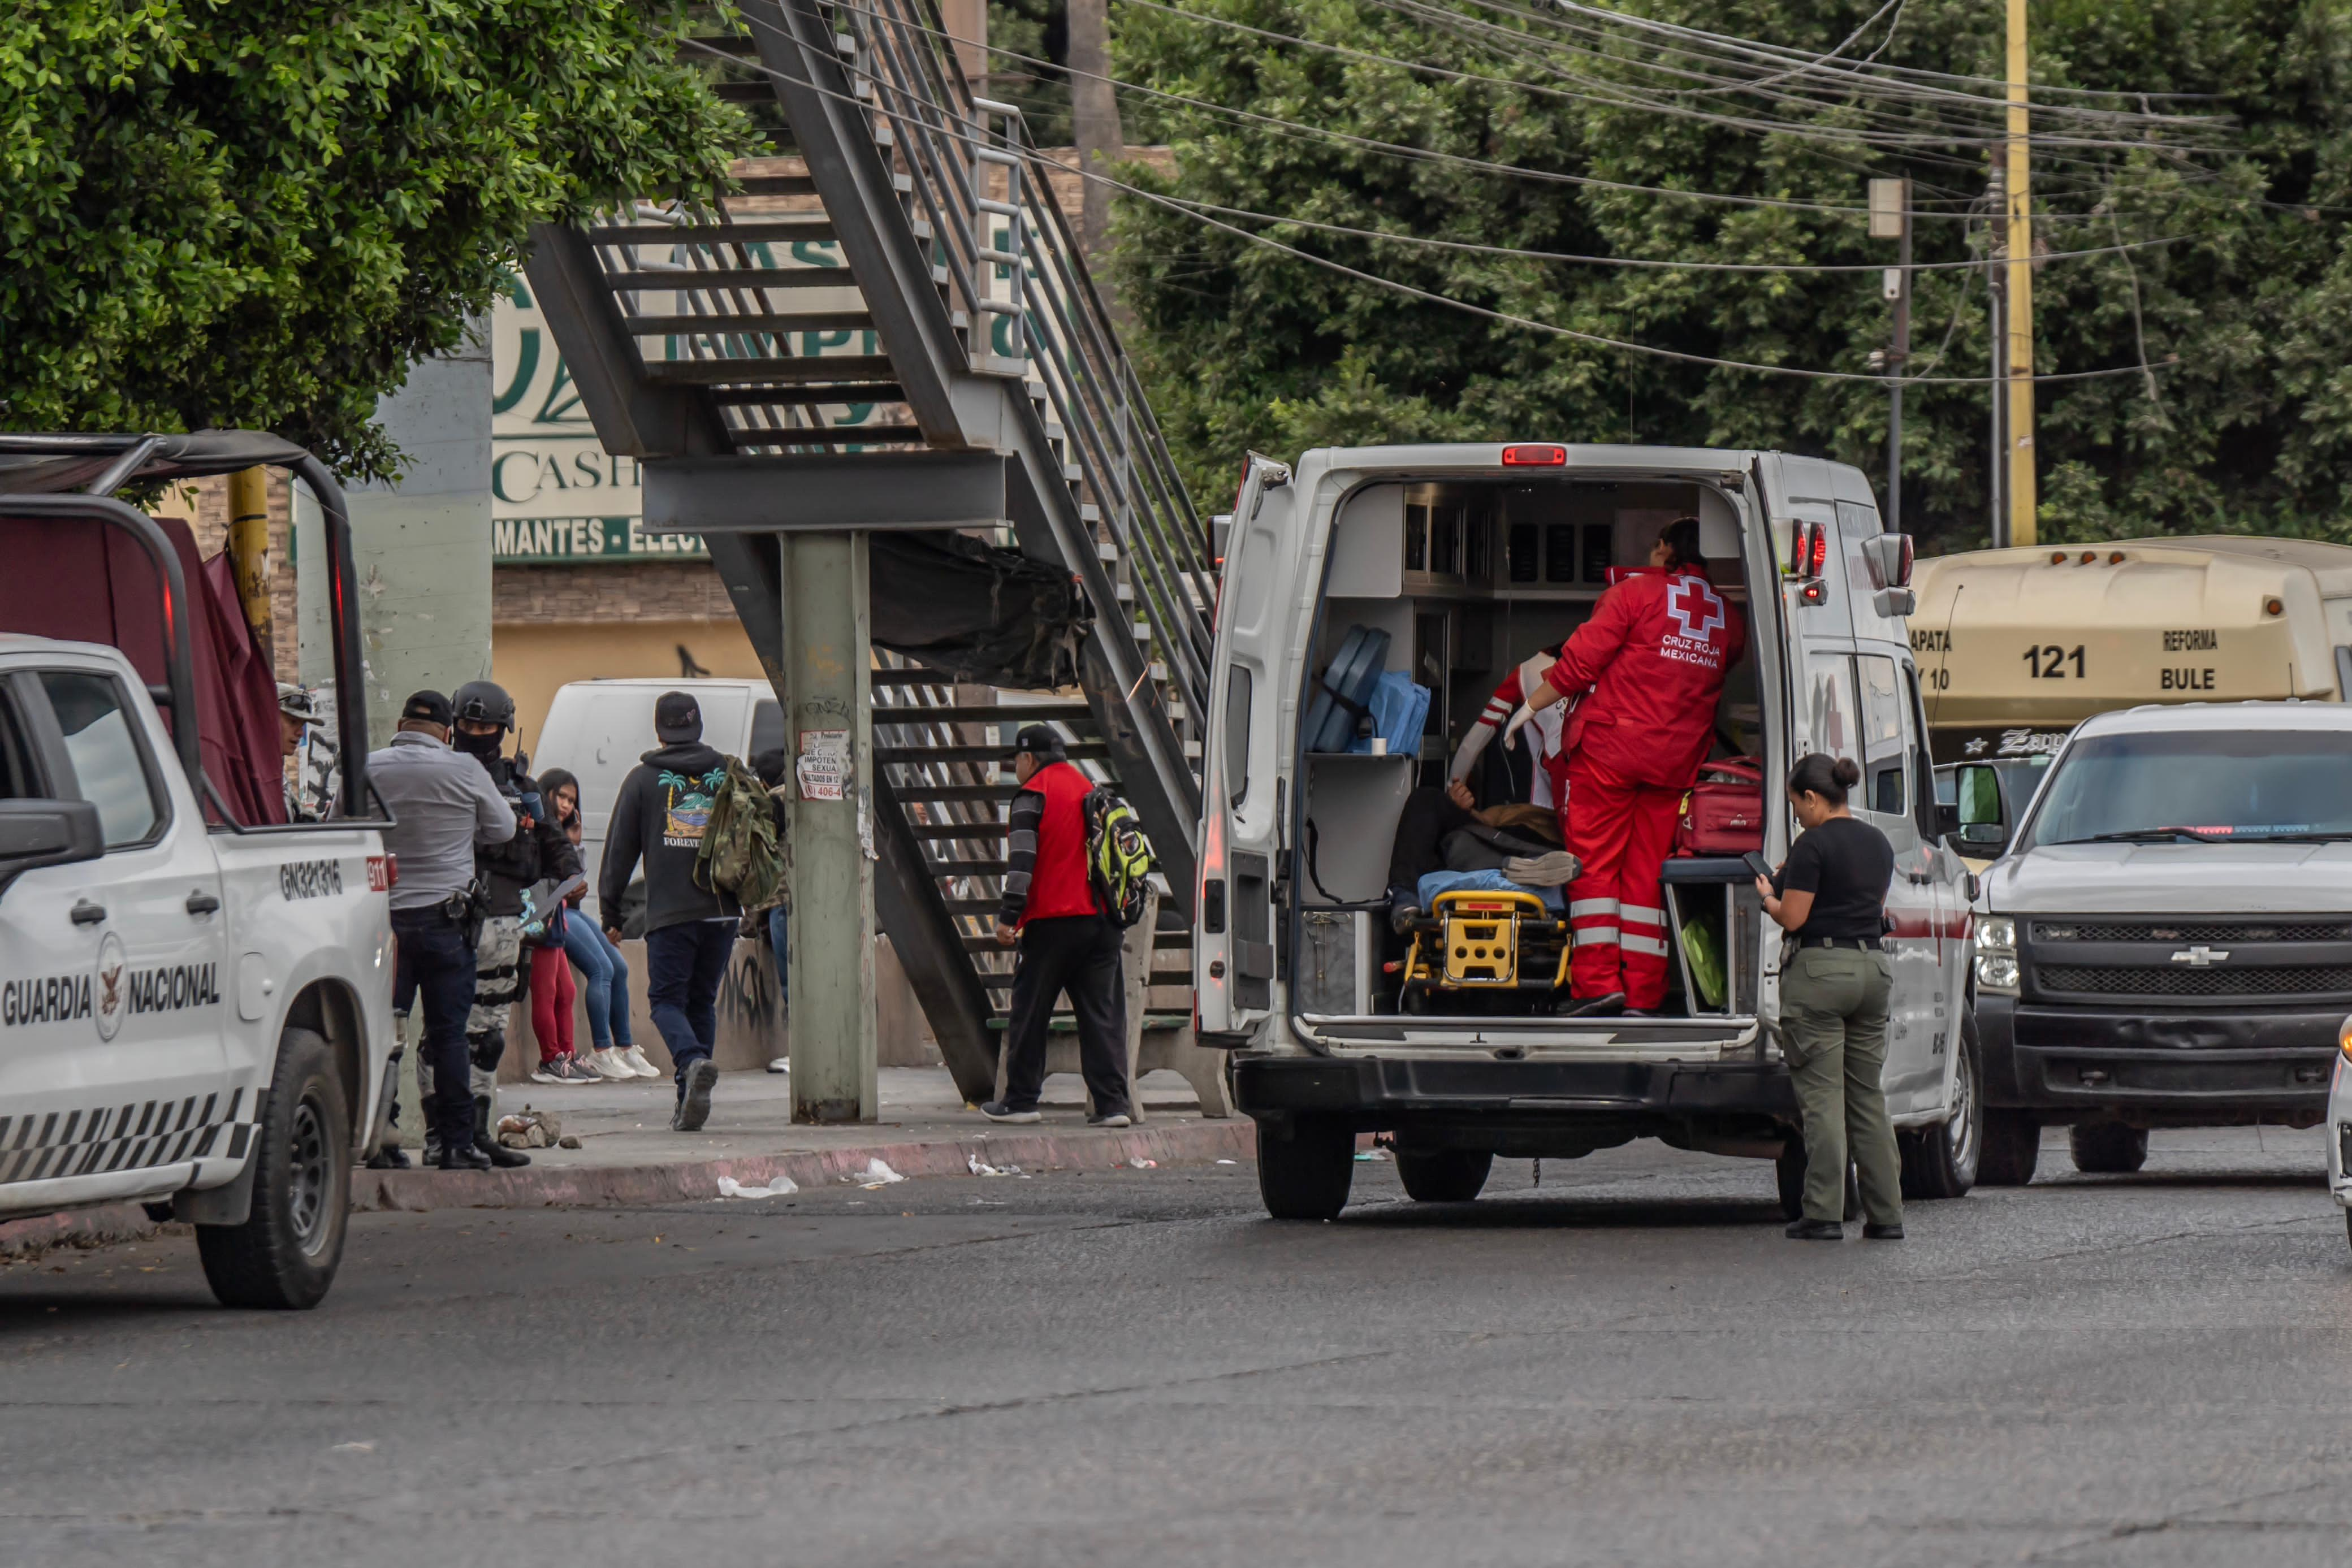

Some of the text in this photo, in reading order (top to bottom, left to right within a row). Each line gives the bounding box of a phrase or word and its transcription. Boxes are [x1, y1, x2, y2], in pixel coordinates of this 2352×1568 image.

[492, 517, 604, 554] MANTES
[1662, 634, 1720, 656] CRUZ ROJA
[1908, 630, 1952, 651] APATA
[2163, 629, 2217, 651] REFORMA
[1660, 647, 1718, 668] MEXICANA
[2022, 644, 2085, 678] 121
[1930, 668, 1949, 690] 10
[2161, 668, 2215, 690] BULE
[818, 787, 841, 796] 406-4
[280, 858, 343, 901] GN321316
[368, 861, 386, 886] 911
[3, 962, 220, 1026] GUARDIA NACIONAL
